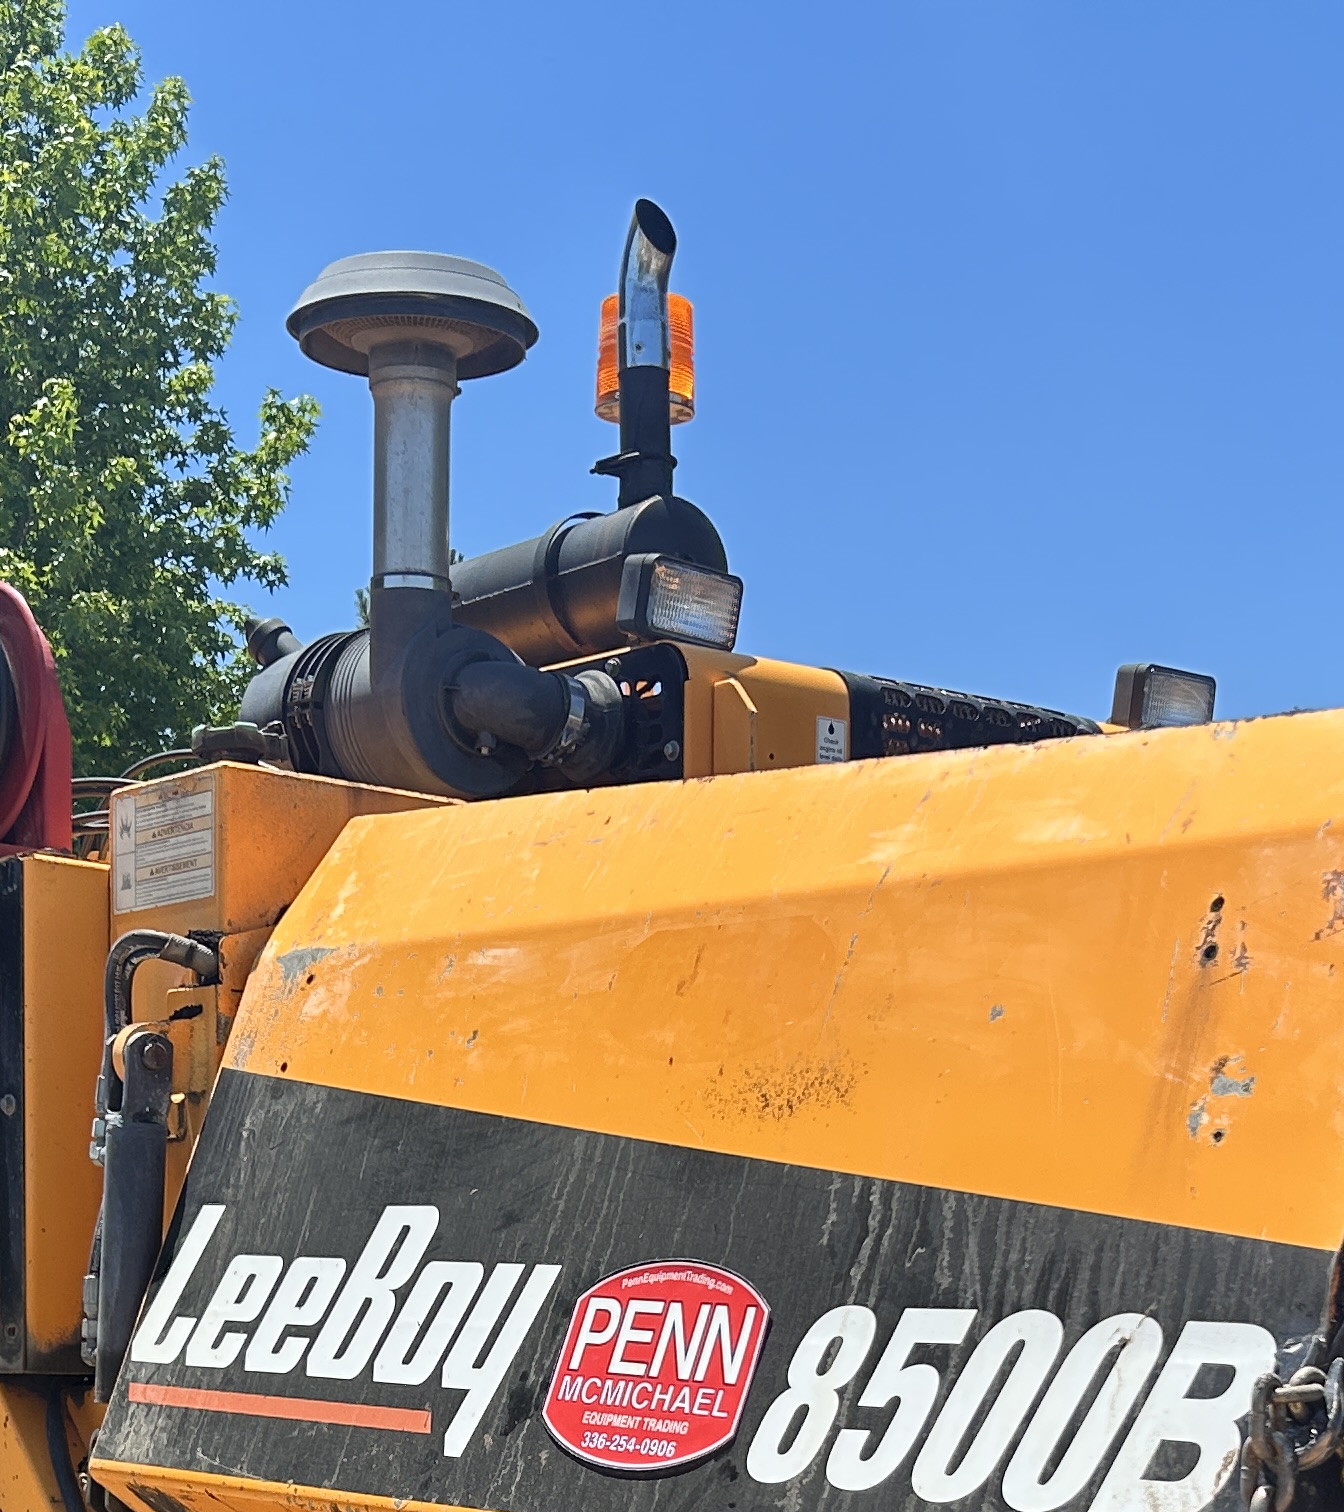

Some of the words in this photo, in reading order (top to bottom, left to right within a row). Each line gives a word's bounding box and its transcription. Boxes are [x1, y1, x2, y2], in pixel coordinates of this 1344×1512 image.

[621, 1270, 734, 1296] PennEquipmentTrading.com
[131, 1204, 562, 1458] LeeBoy
[567, 1297, 757, 1385] PENN
[557, 1375, 729, 1418] MCMICHAEL
[582, 1410, 642, 1429] EQUIPMENT
[642, 1417, 690, 1435] TRADING
[581, 1432, 677, 1457] 336-254-0906
